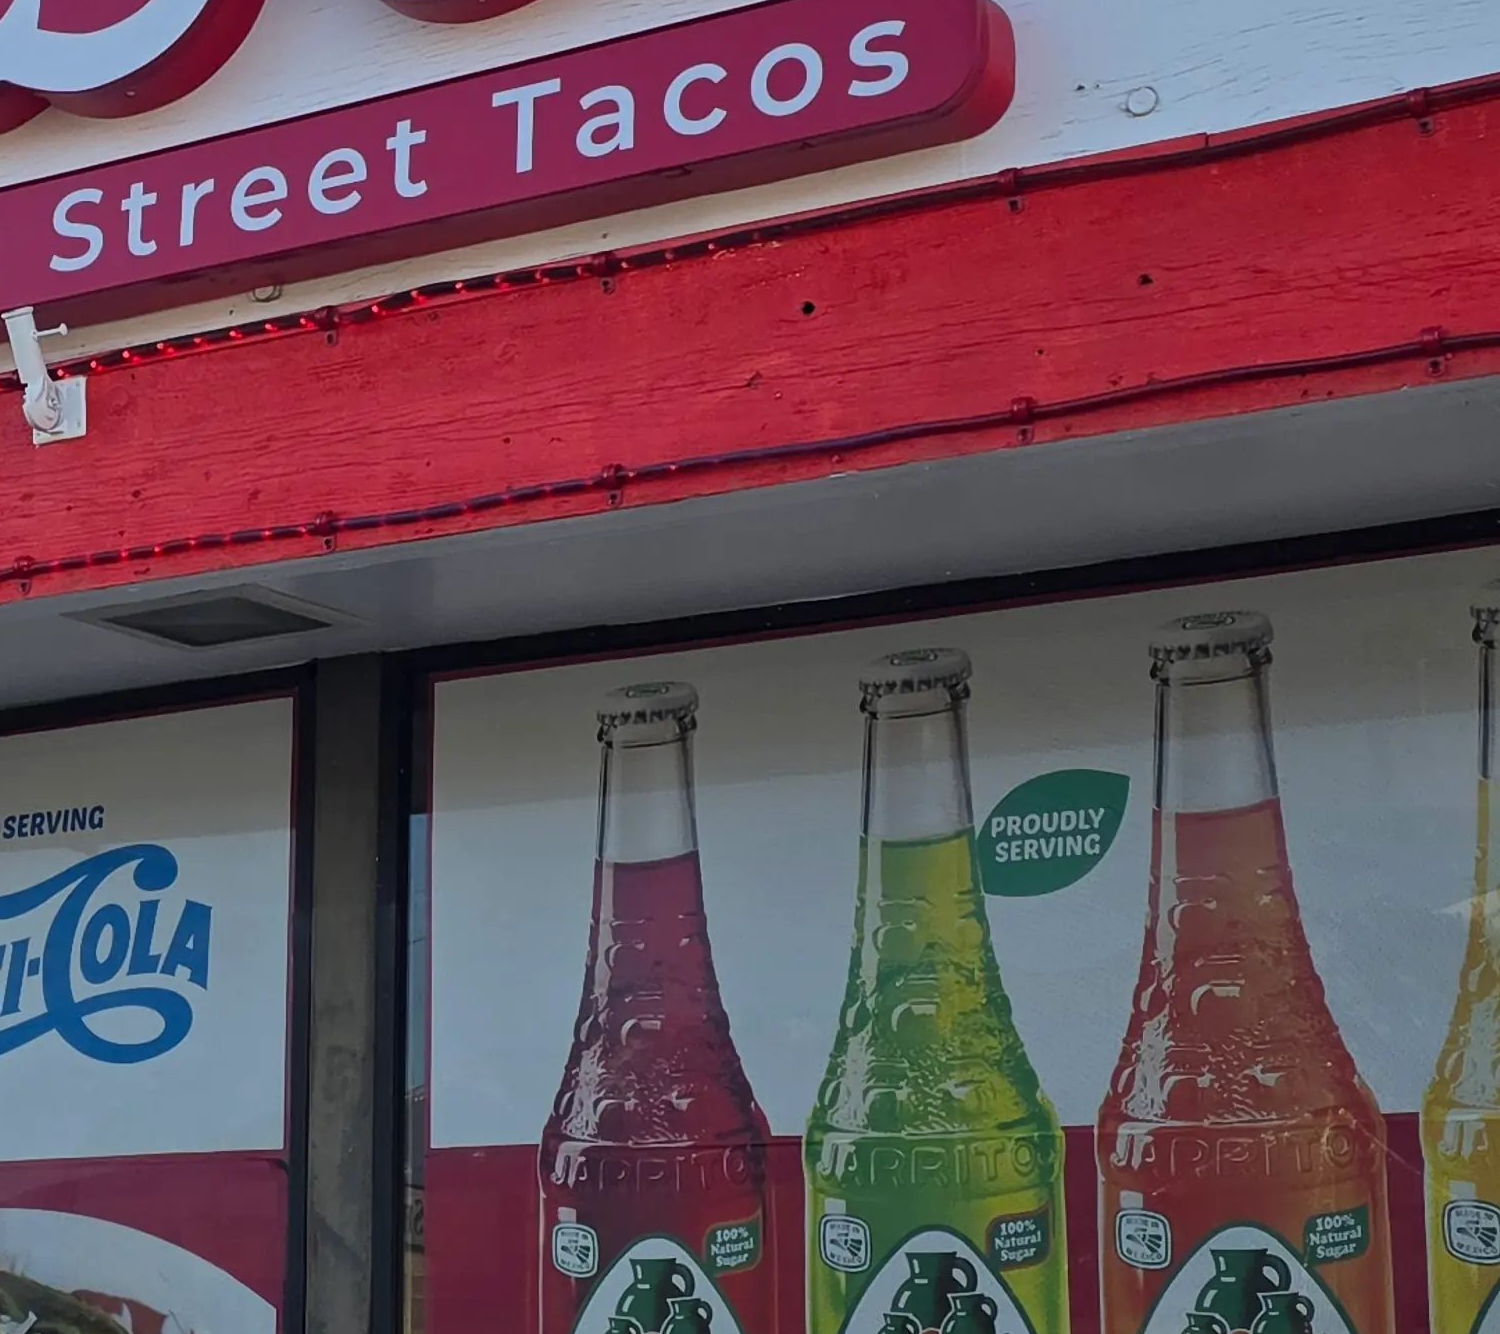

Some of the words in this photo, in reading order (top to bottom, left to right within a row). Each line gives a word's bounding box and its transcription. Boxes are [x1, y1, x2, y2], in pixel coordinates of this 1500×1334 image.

[50, 120, 428, 272] Street
[492, 20, 909, 175] Tacos
[3, 805, 104, 839] SERVING
[991, 808, 1105, 838] PROUDLY
[995, 834, 1101, 862] SERVING
[1000, 1219, 1036, 1236] 100%
[1316, 1213, 1355, 1231] 100%
[716, 1227, 749, 1242] 100%
[994, 1230, 1042, 1250] Natural
[1309, 1225, 1362, 1246] Natural
[710, 1237, 754, 1255] Natural
[1000, 1248, 1037, 1262] Sugar
[1316, 1243, 1356, 1259] Sugar
